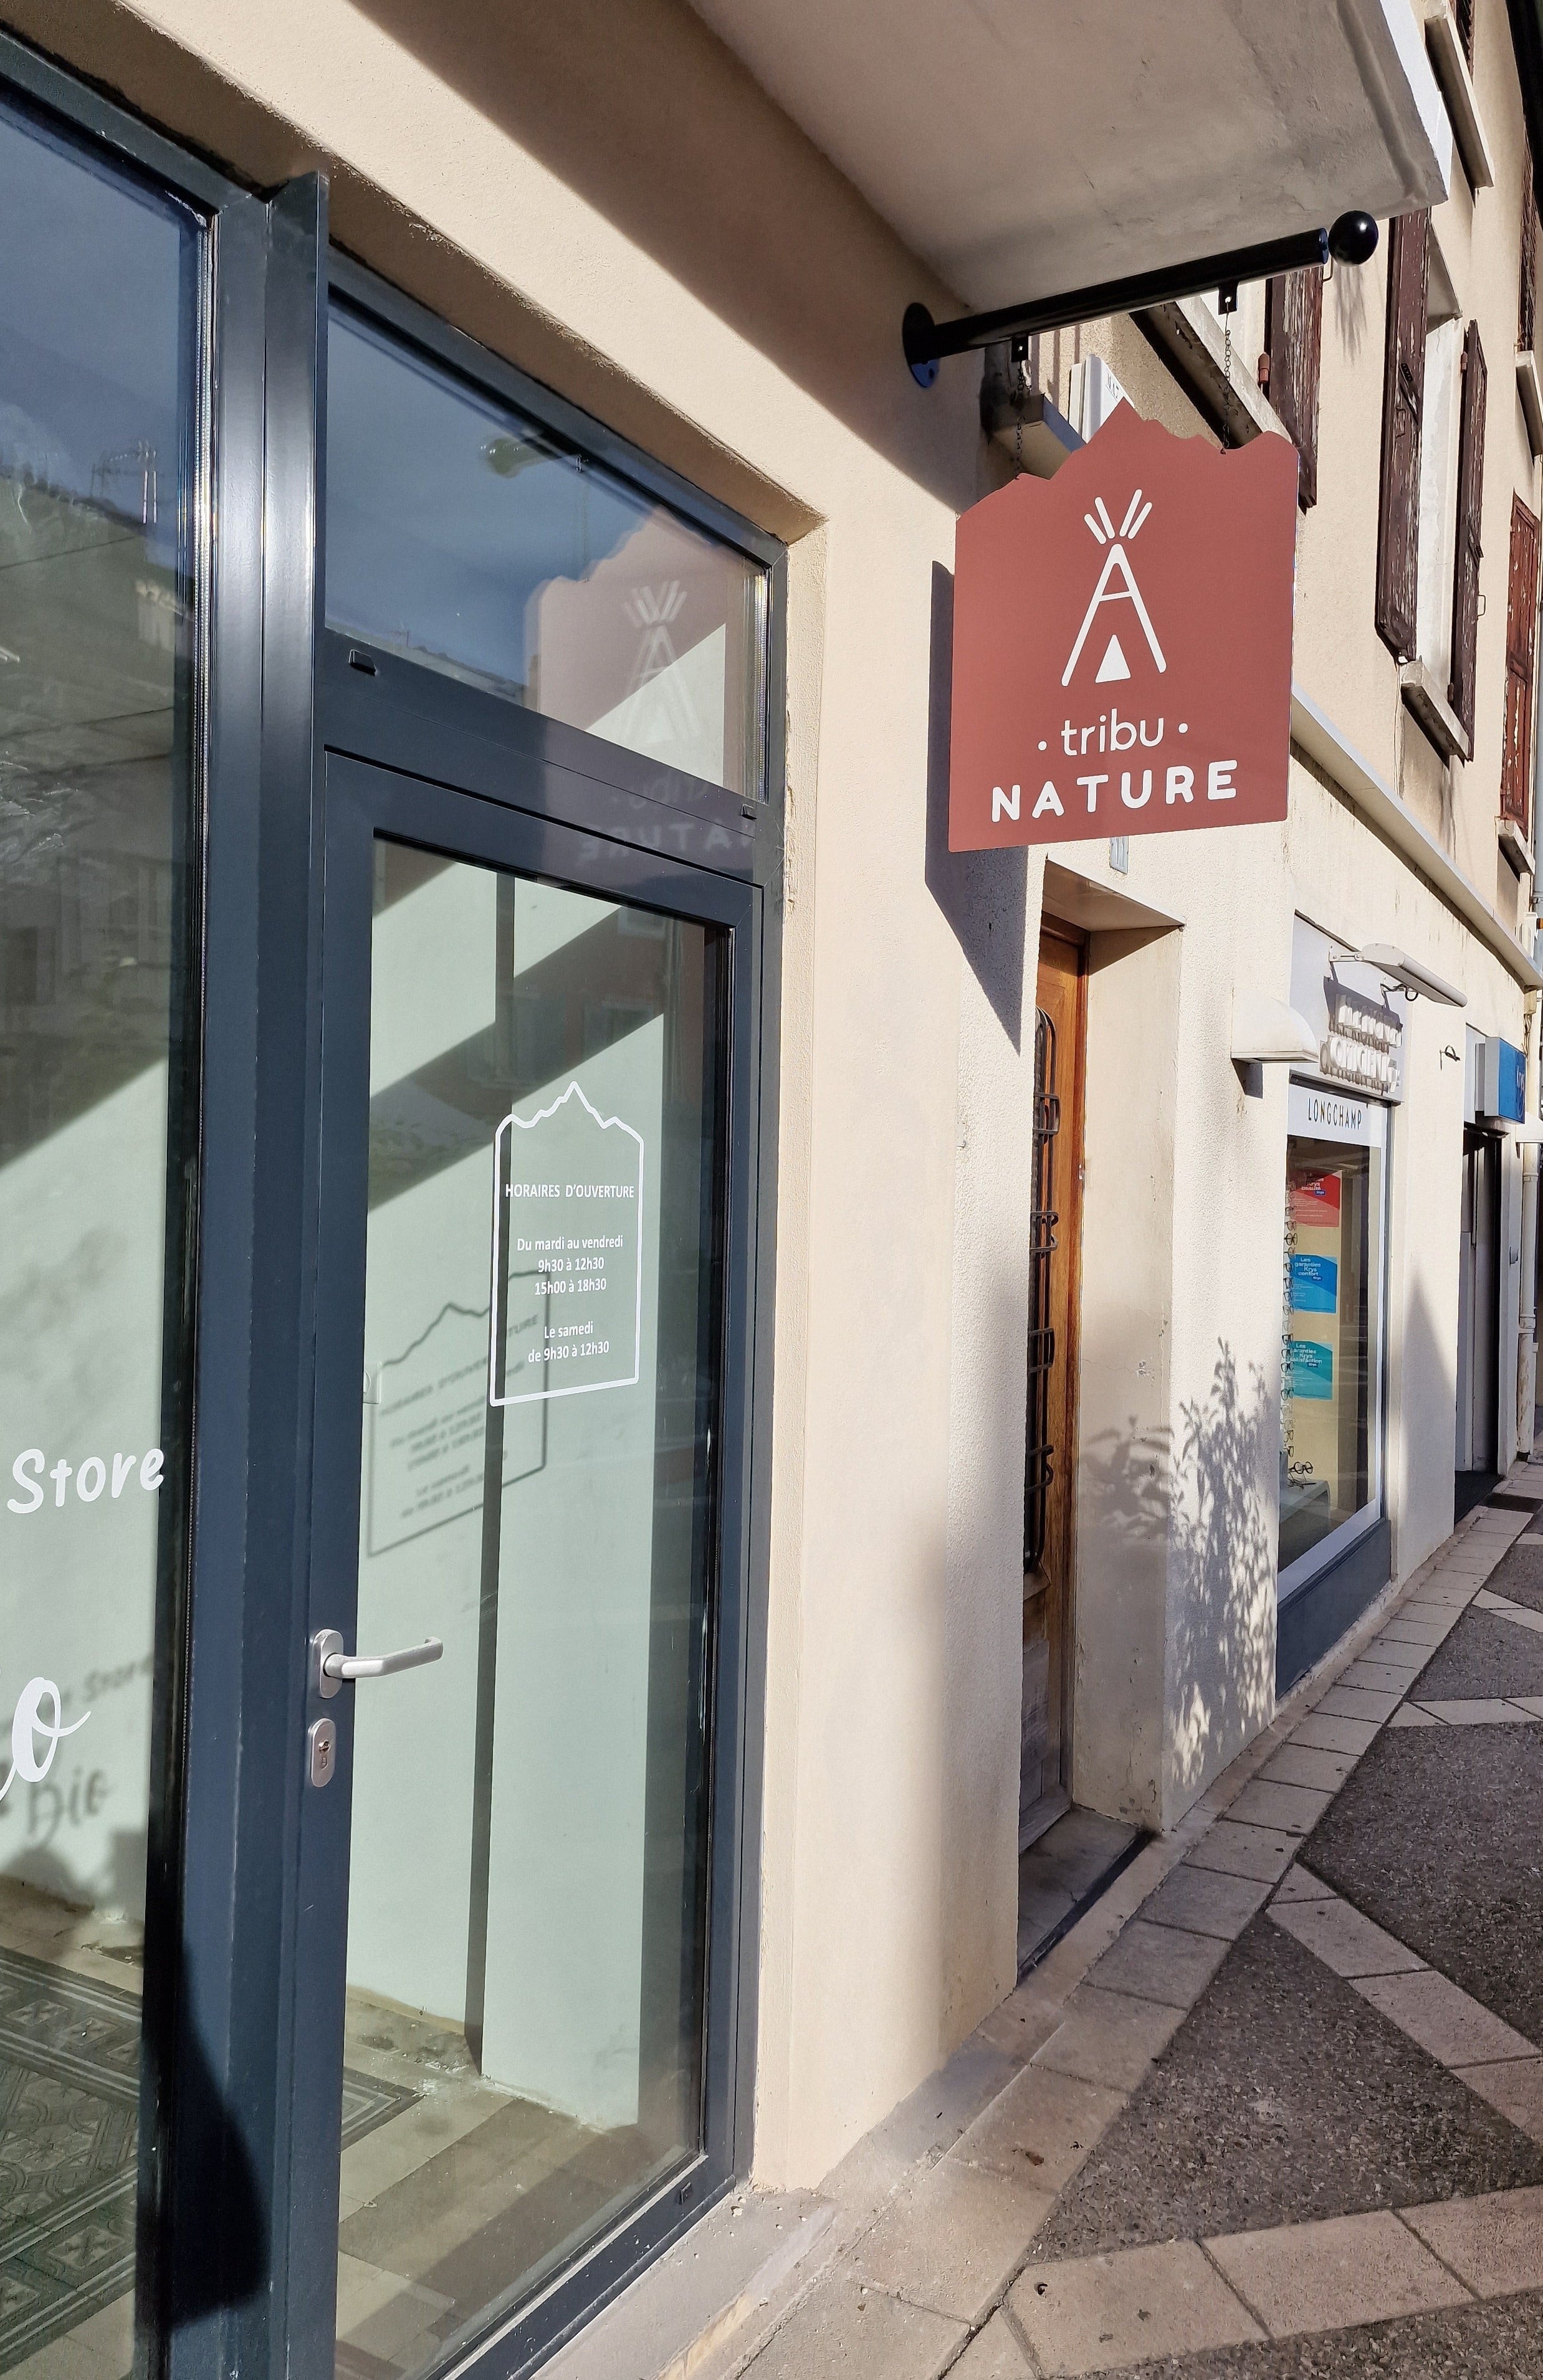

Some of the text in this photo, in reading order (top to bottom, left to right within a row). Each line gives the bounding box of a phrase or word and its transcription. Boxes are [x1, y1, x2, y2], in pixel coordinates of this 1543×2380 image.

[1061, 708, 1164, 756] tribu
[991, 759, 1238, 822] NATURE
[1308, 1098, 1362, 1130] LONGCHAMP
[505, 1184, 560, 1198] HORAIRES
[517, 1235, 623, 1251] Du mardi au vendredi
[538, 1257, 604, 1273] 9h30 à 12h30
[535, 1277, 607, 1295] 15h00 à 18h30
[544, 1326, 556, 1339] Le
[558, 1321, 594, 1337] samedi
[528, 1340, 609, 1363] de 9h30 à 12h30
[7, 1448, 165, 1514] Store
